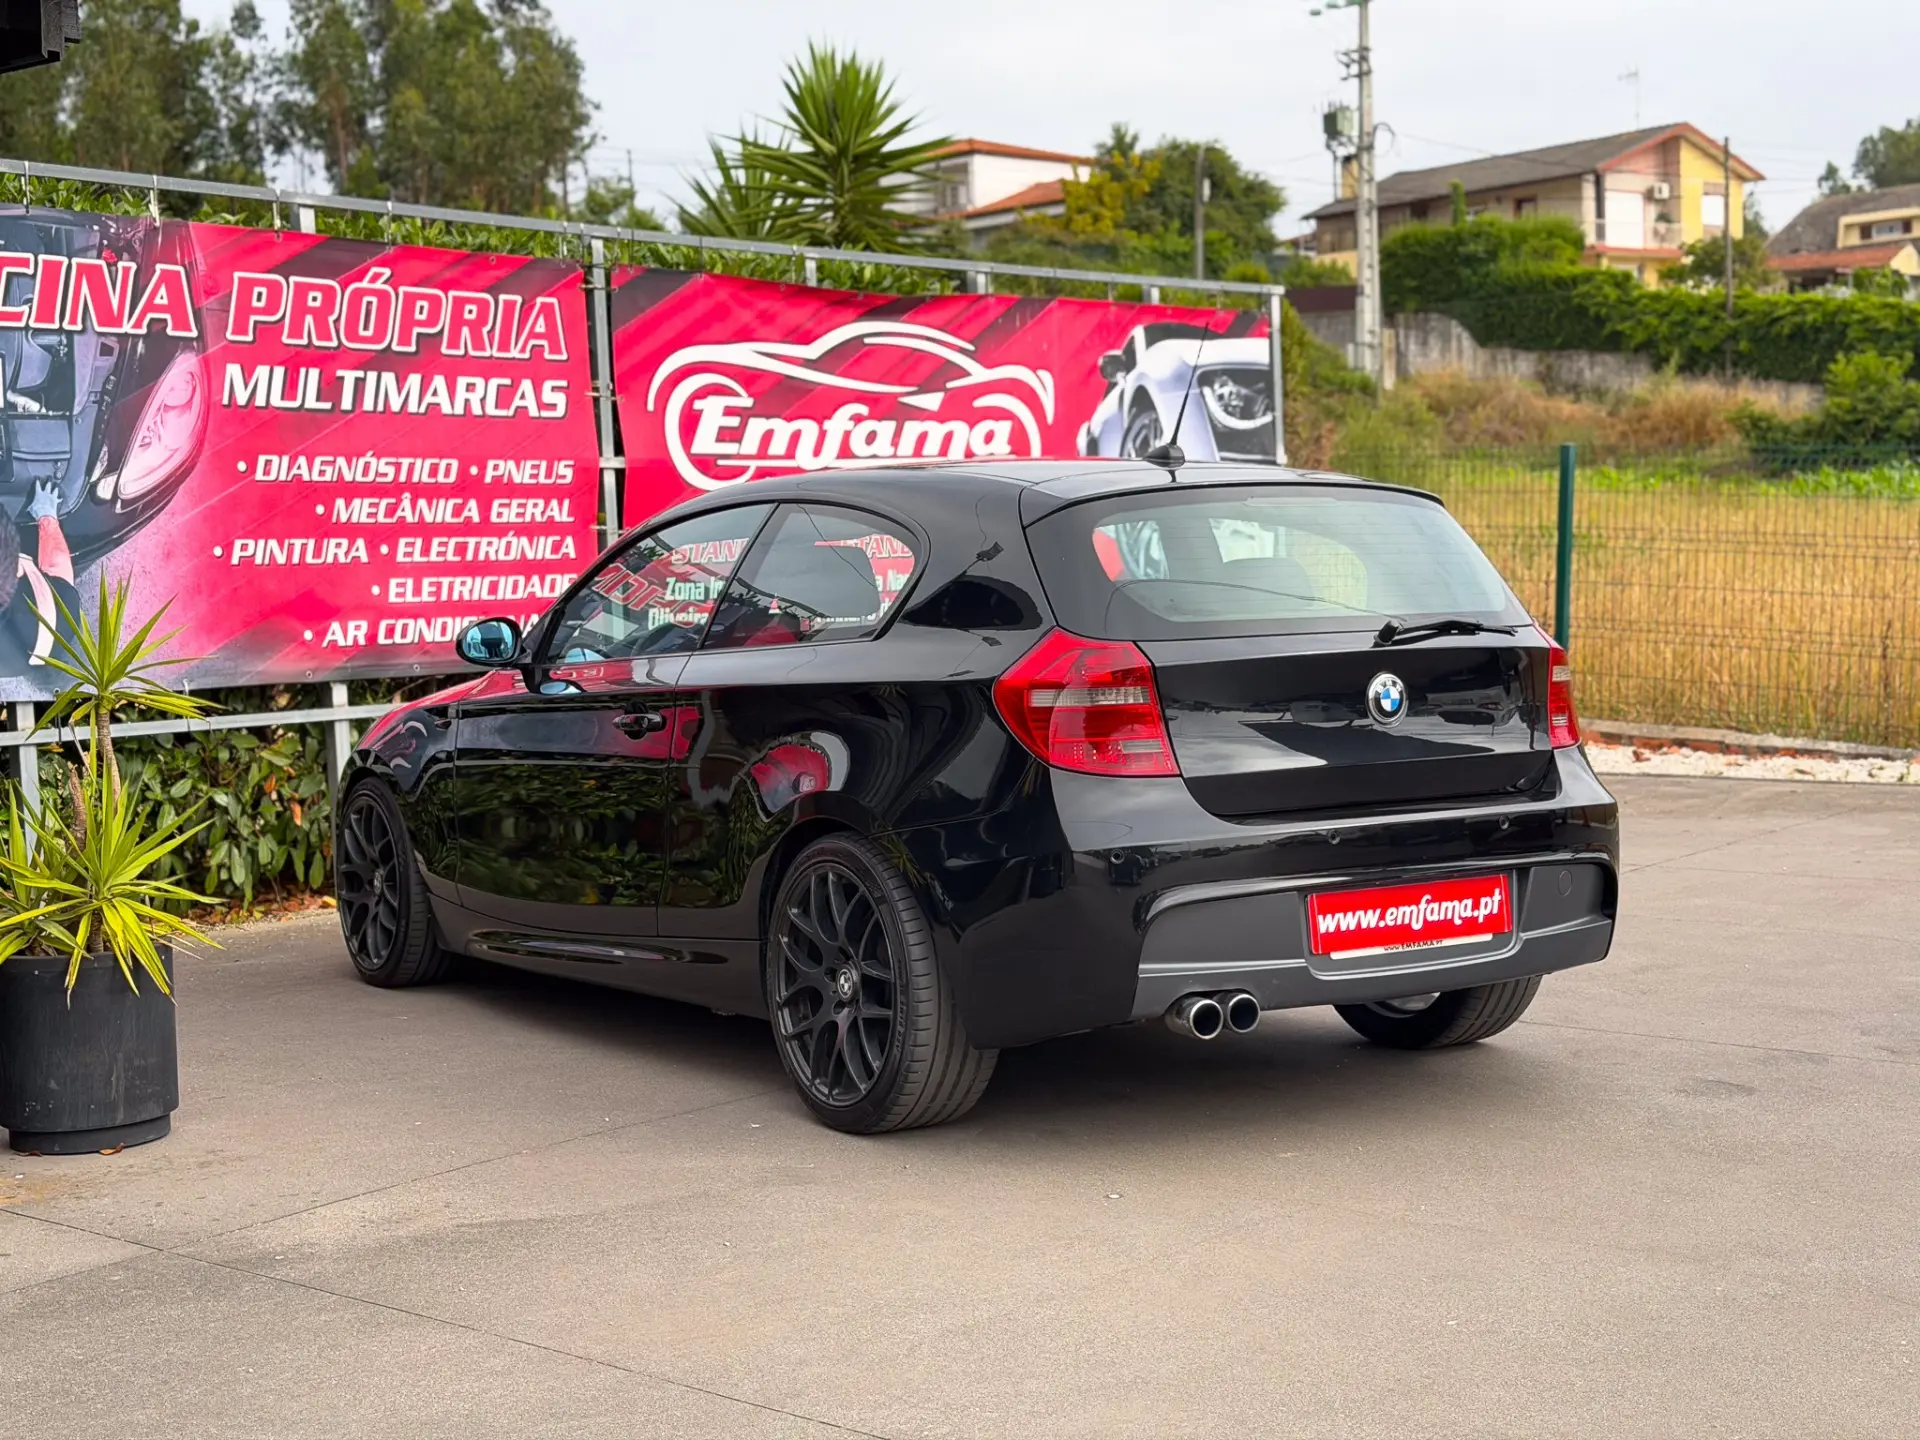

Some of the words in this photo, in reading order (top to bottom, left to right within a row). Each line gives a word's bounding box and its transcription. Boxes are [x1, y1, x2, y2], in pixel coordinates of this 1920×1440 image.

[226, 267, 568, 361] PRÓPRIA
[222, 363, 568, 418] MULTIMARCAS
[690, 396, 1013, 471] Emfama
[255, 451, 458, 484] DIAGNÓSTICO
[484, 459, 574, 484] PNEUS
[332, 494, 480, 524] MECÂNICA
[490, 498, 574, 523] GERAL
[231, 538, 369, 566] PINTURA
[396, 534, 576, 562] ELECTRÓNICA
[672, 538, 749, 564] STAN
[388, 574, 577, 603] ELETRICIDADE
[322, 621, 367, 648] AR
[1317, 888, 1502, 934] www.emfama.pt
